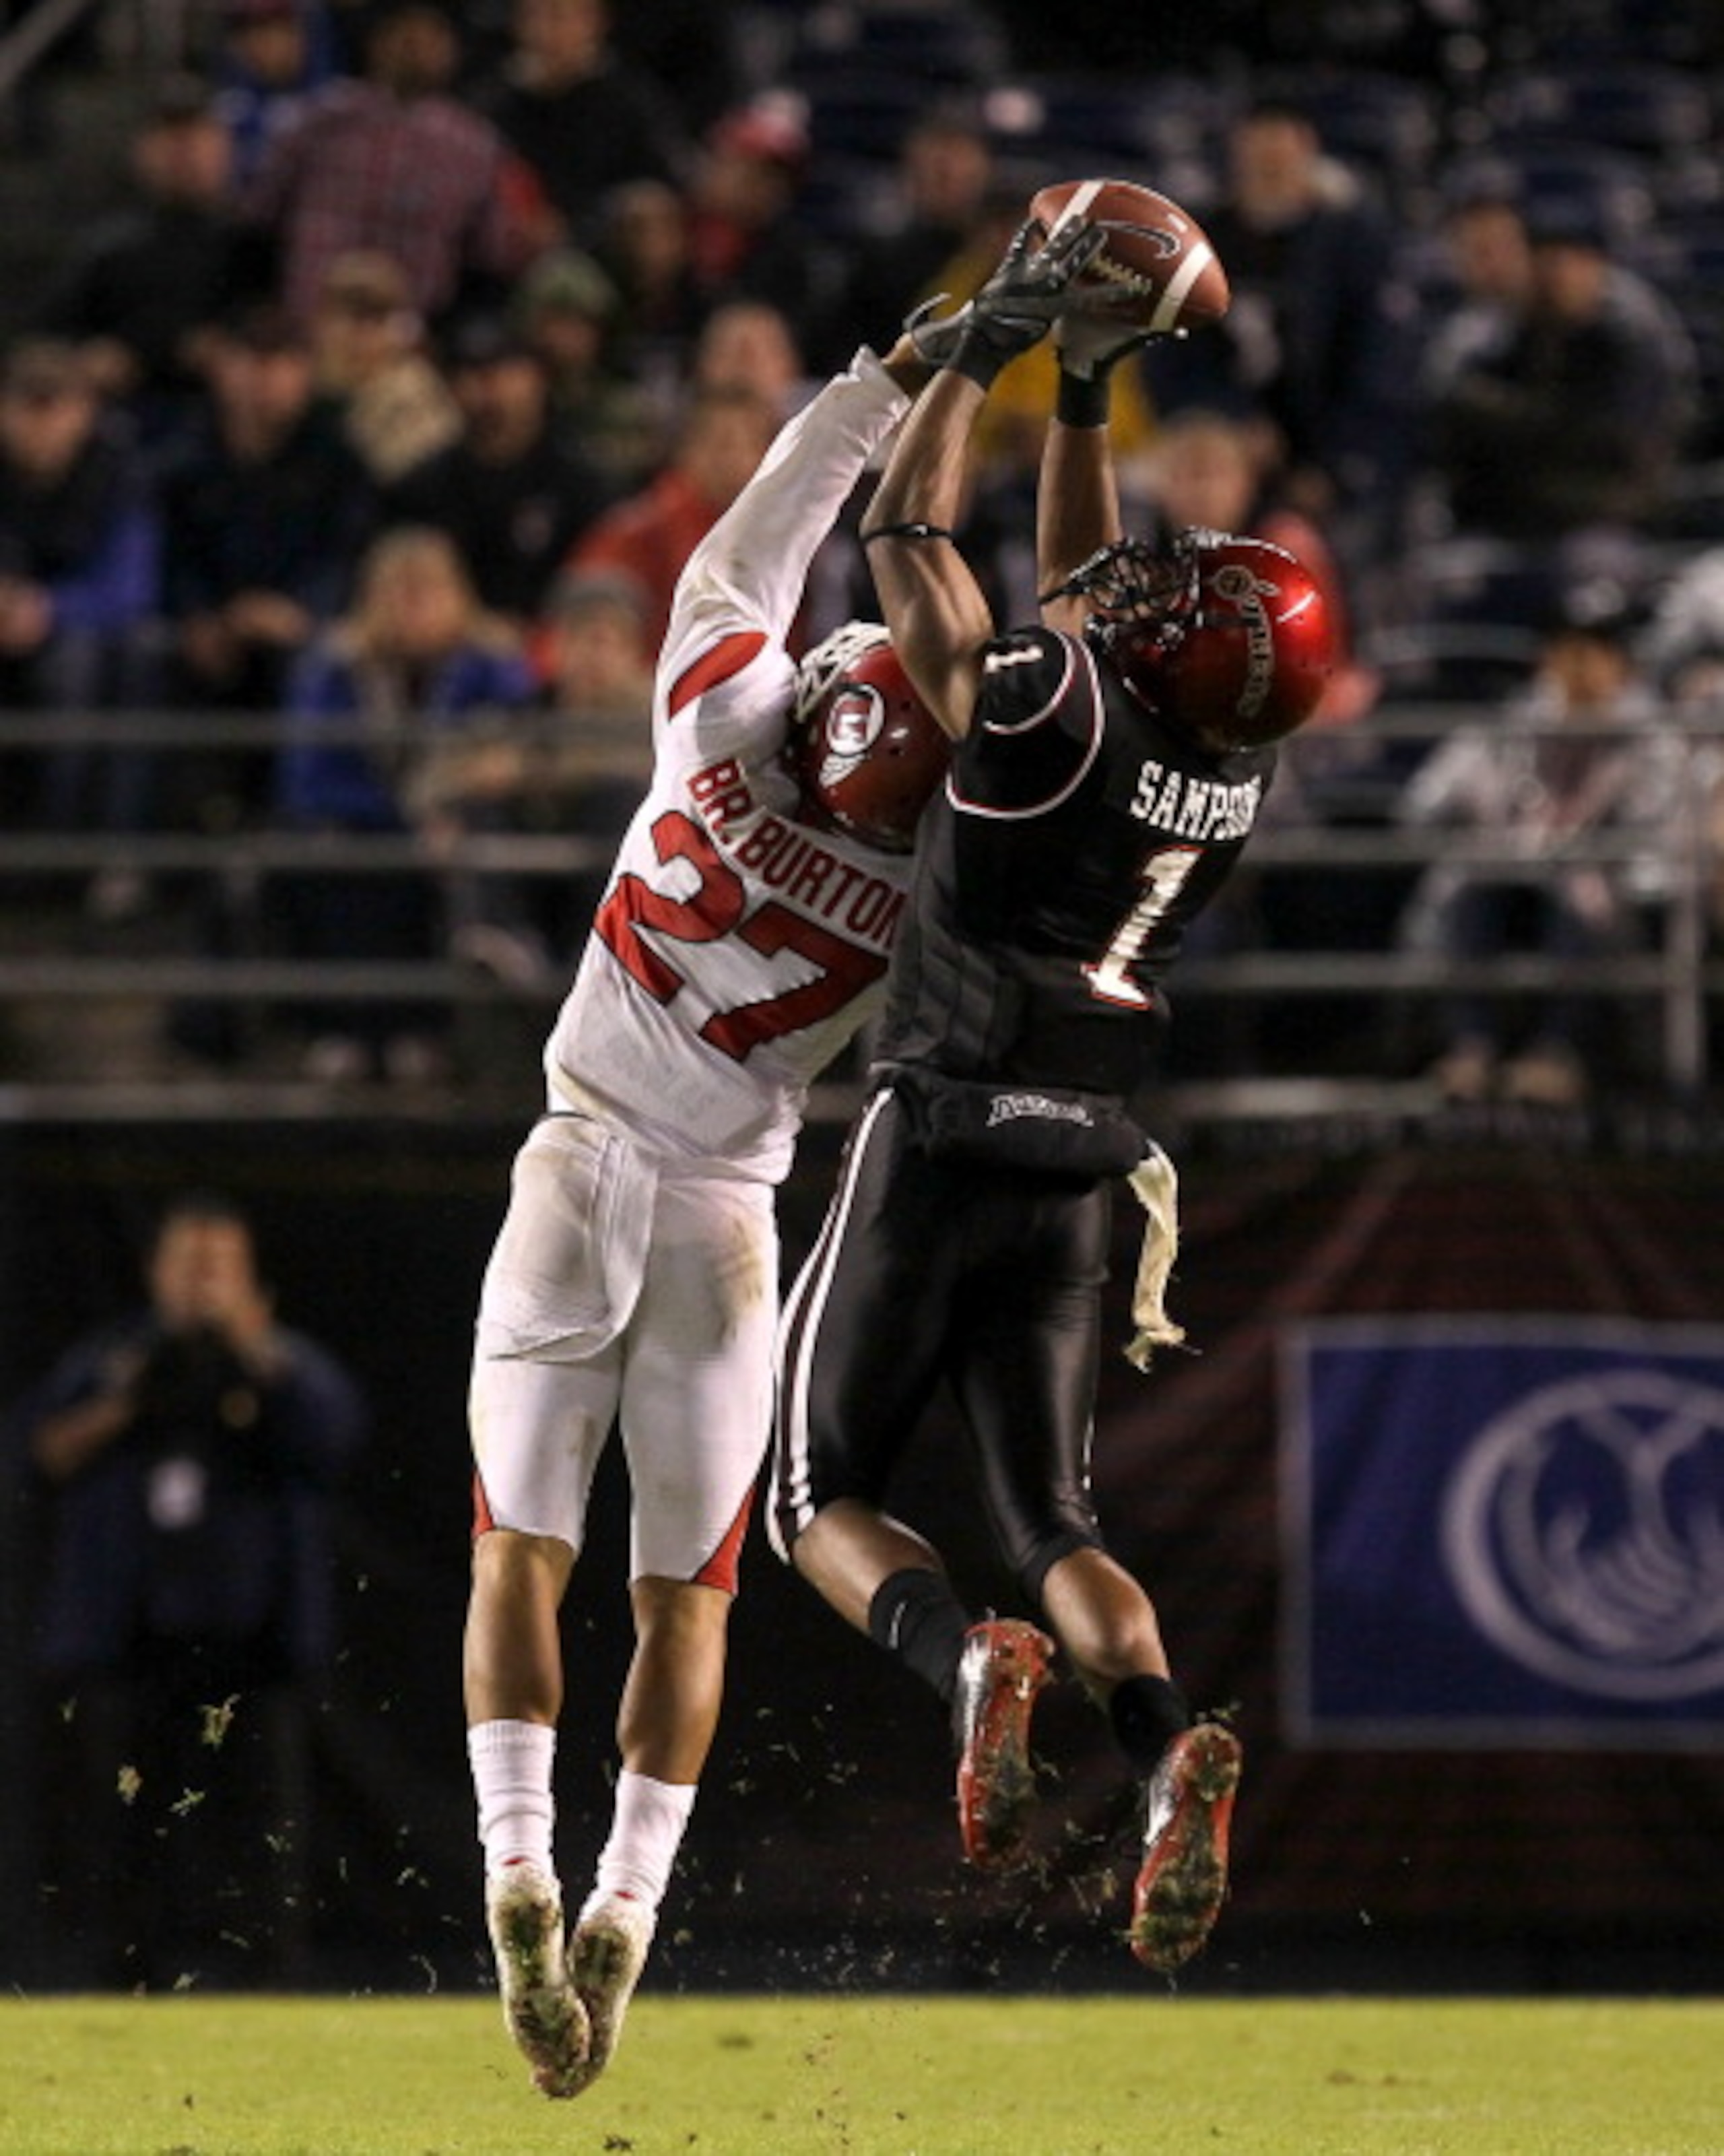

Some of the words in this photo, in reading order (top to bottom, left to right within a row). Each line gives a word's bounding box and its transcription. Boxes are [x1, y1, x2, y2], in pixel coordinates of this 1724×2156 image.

[985, 645, 1044, 674] 1
[593, 810, 889, 1063] 27
[1081, 845, 1204, 1008] 1
